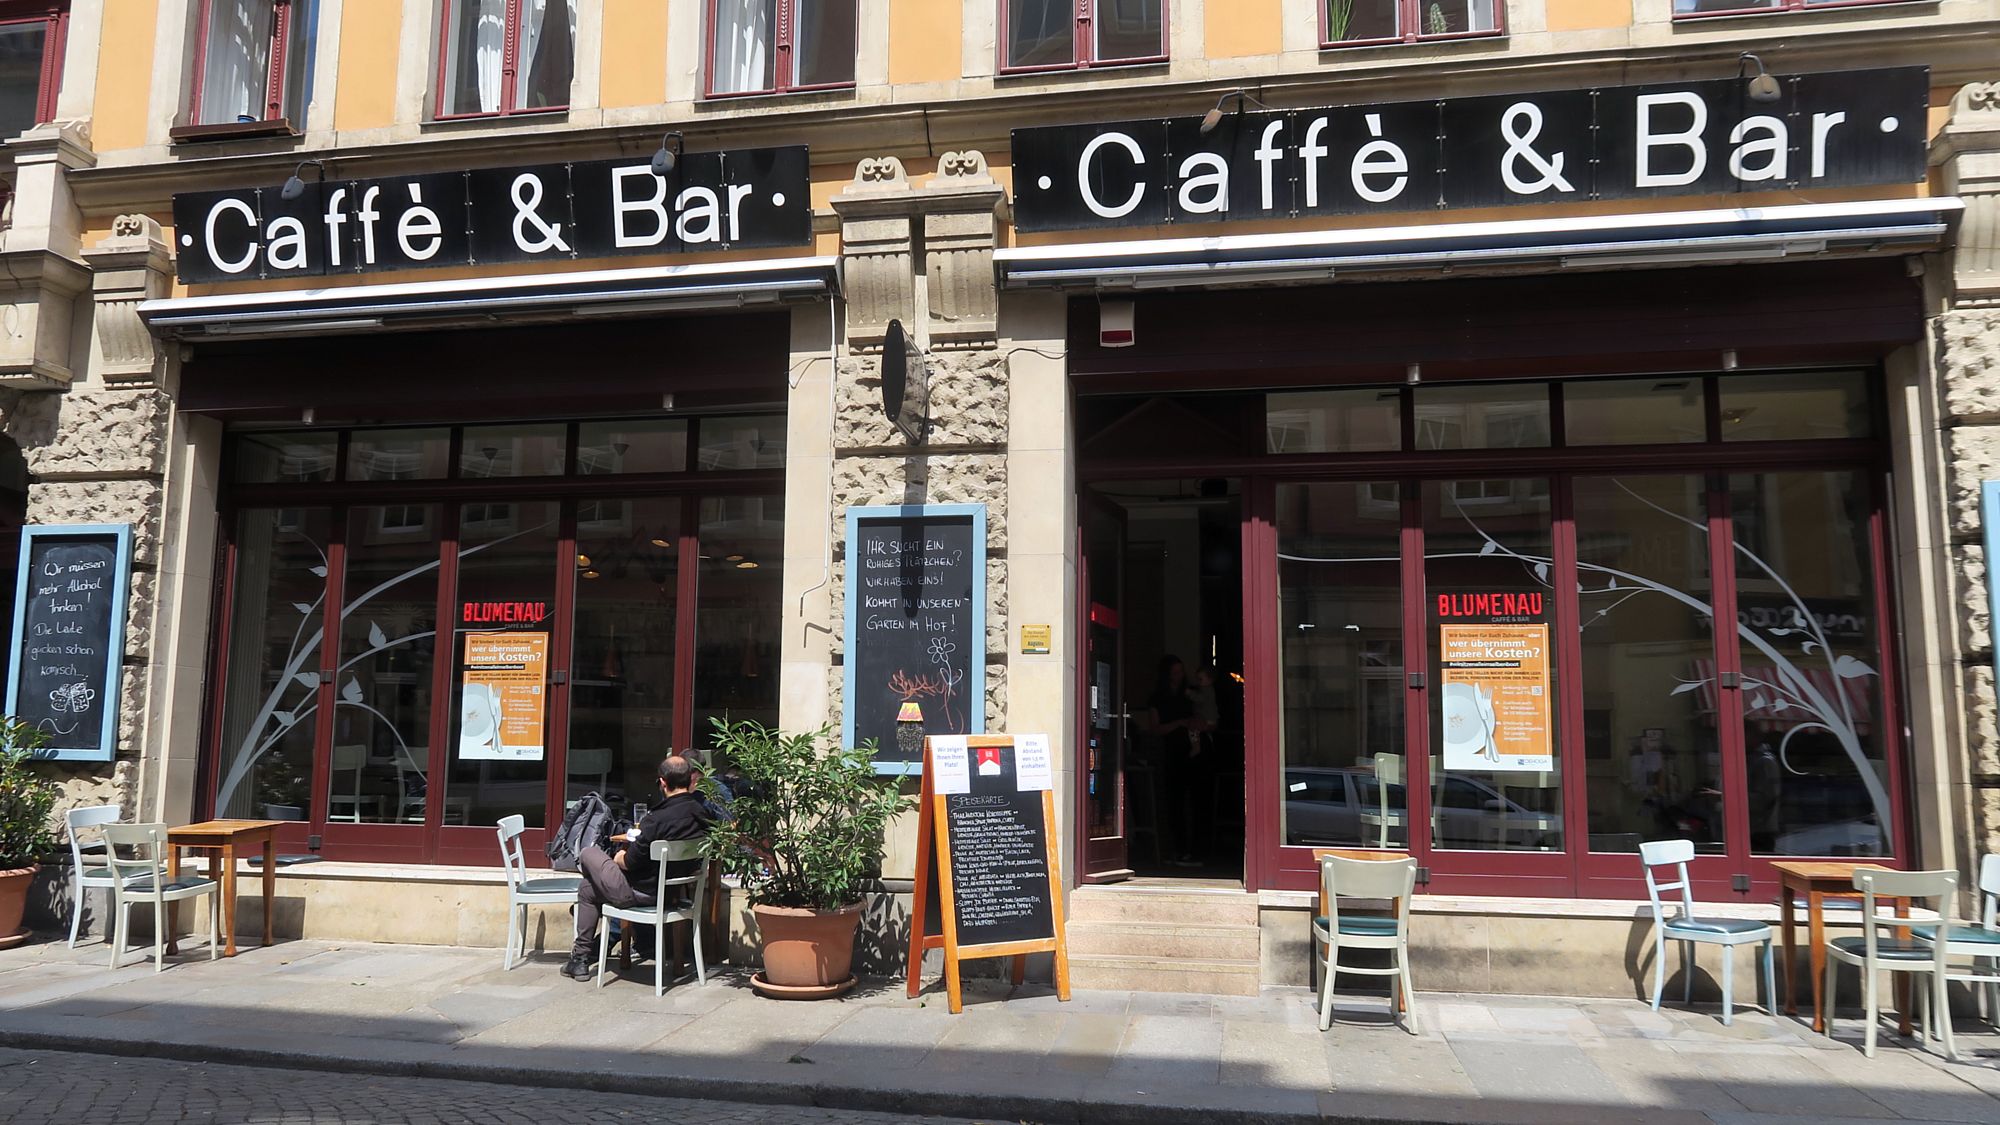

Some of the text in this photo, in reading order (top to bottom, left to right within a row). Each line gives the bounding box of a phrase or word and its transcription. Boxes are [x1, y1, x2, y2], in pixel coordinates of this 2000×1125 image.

[1078, 91, 1846, 219] Caffè & Bar
[205, 164, 753, 274] Caffè & Bar
[866, 540, 944, 555] IHR SUCHT EIN
[866, 558, 901, 569] RUHIGES
[917, 571, 944, 586] EINS!
[865, 595, 961, 609] KOMMT IN UNSEREN
[1438, 592, 1543, 617] BLUMENAU
[463, 602, 545, 622] BLUMENAU
[866, 614, 905, 631] GARTEN
[910, 620, 919, 631] IM
[488, 645, 532, 653] übernimmt
[1471, 639, 1526, 648] übernimmt
[499, 652, 542, 662] Kosten?
[1449, 647, 1541, 658] unsere Kosten?
